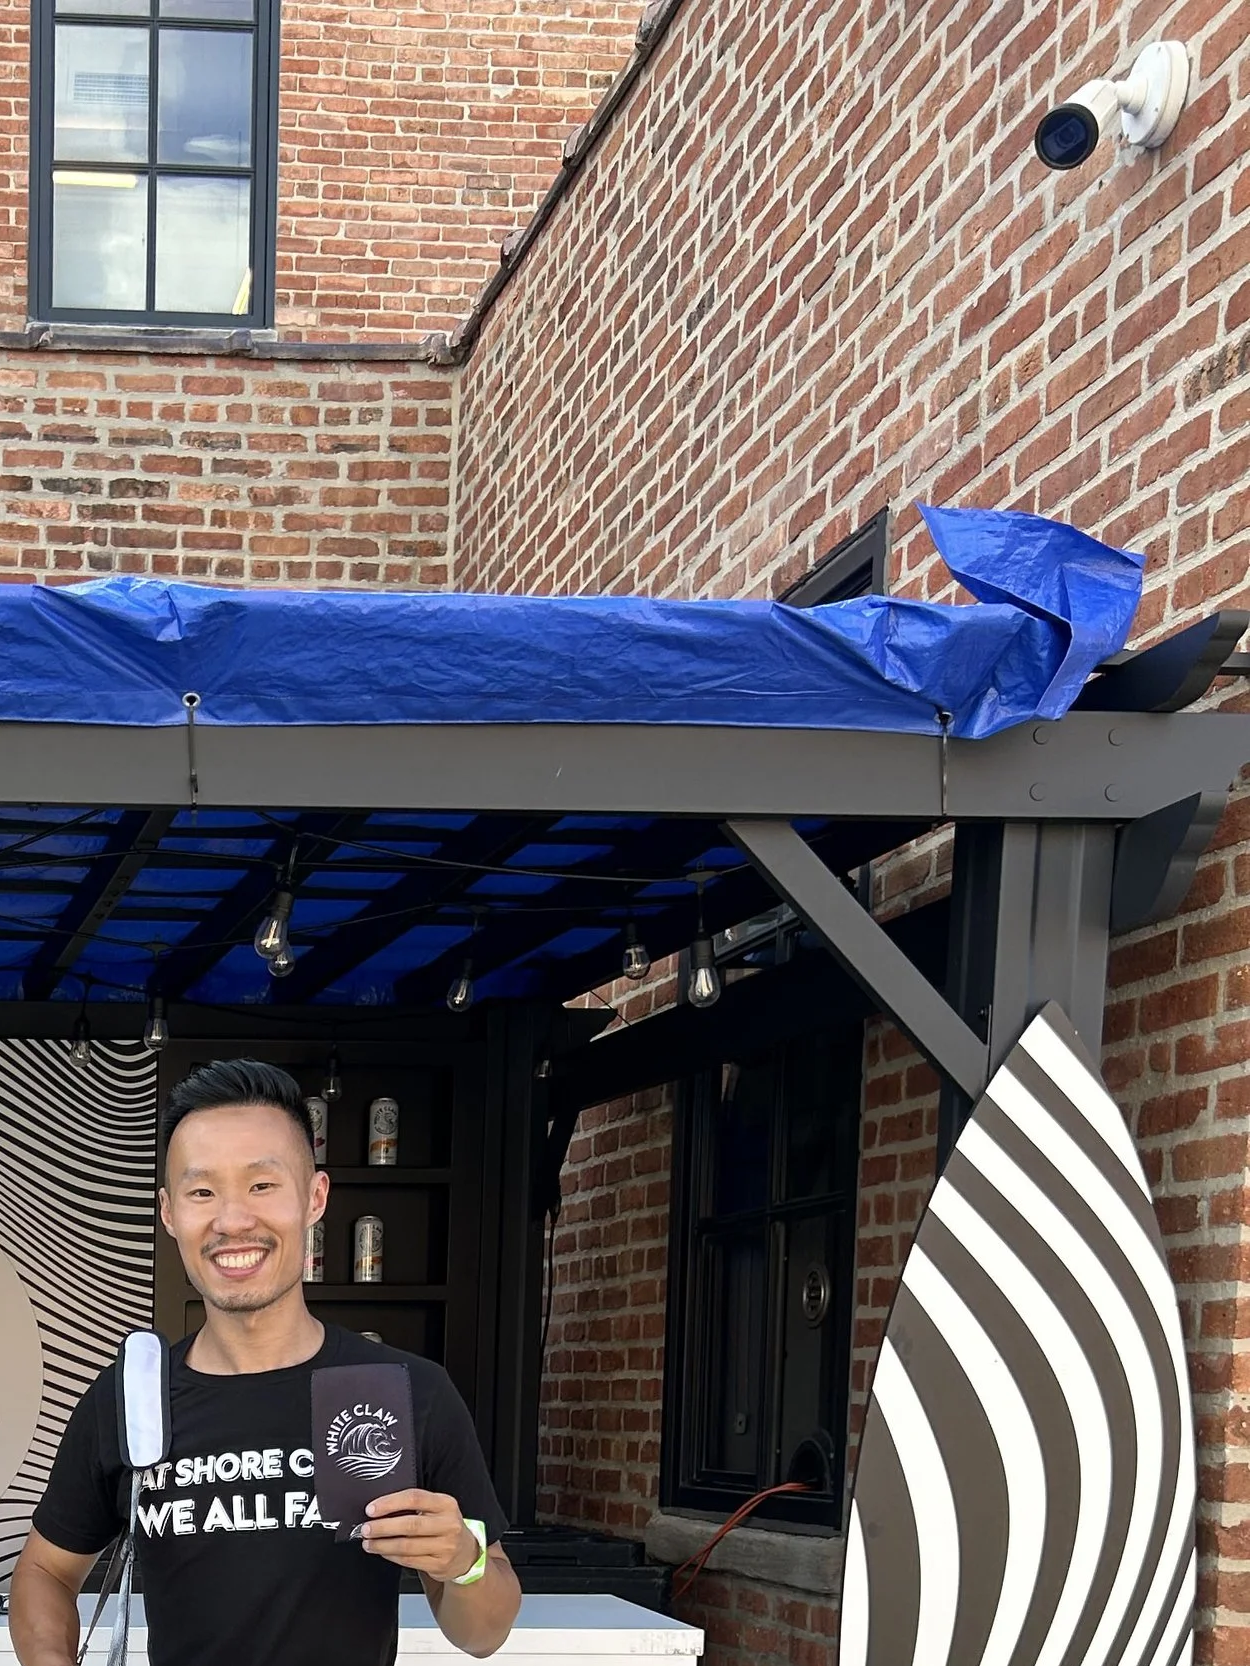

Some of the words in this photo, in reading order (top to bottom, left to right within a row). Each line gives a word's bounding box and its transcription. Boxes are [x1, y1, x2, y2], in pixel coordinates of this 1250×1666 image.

[326, 1409, 352, 1456] WHITE
[353, 1404, 398, 1426] CLAW
[141, 1462, 172, 1491] AT
[175, 1448, 283, 1487] SHORE
[137, 1498, 197, 1539] WE
[203, 1493, 279, 1532] ALL
